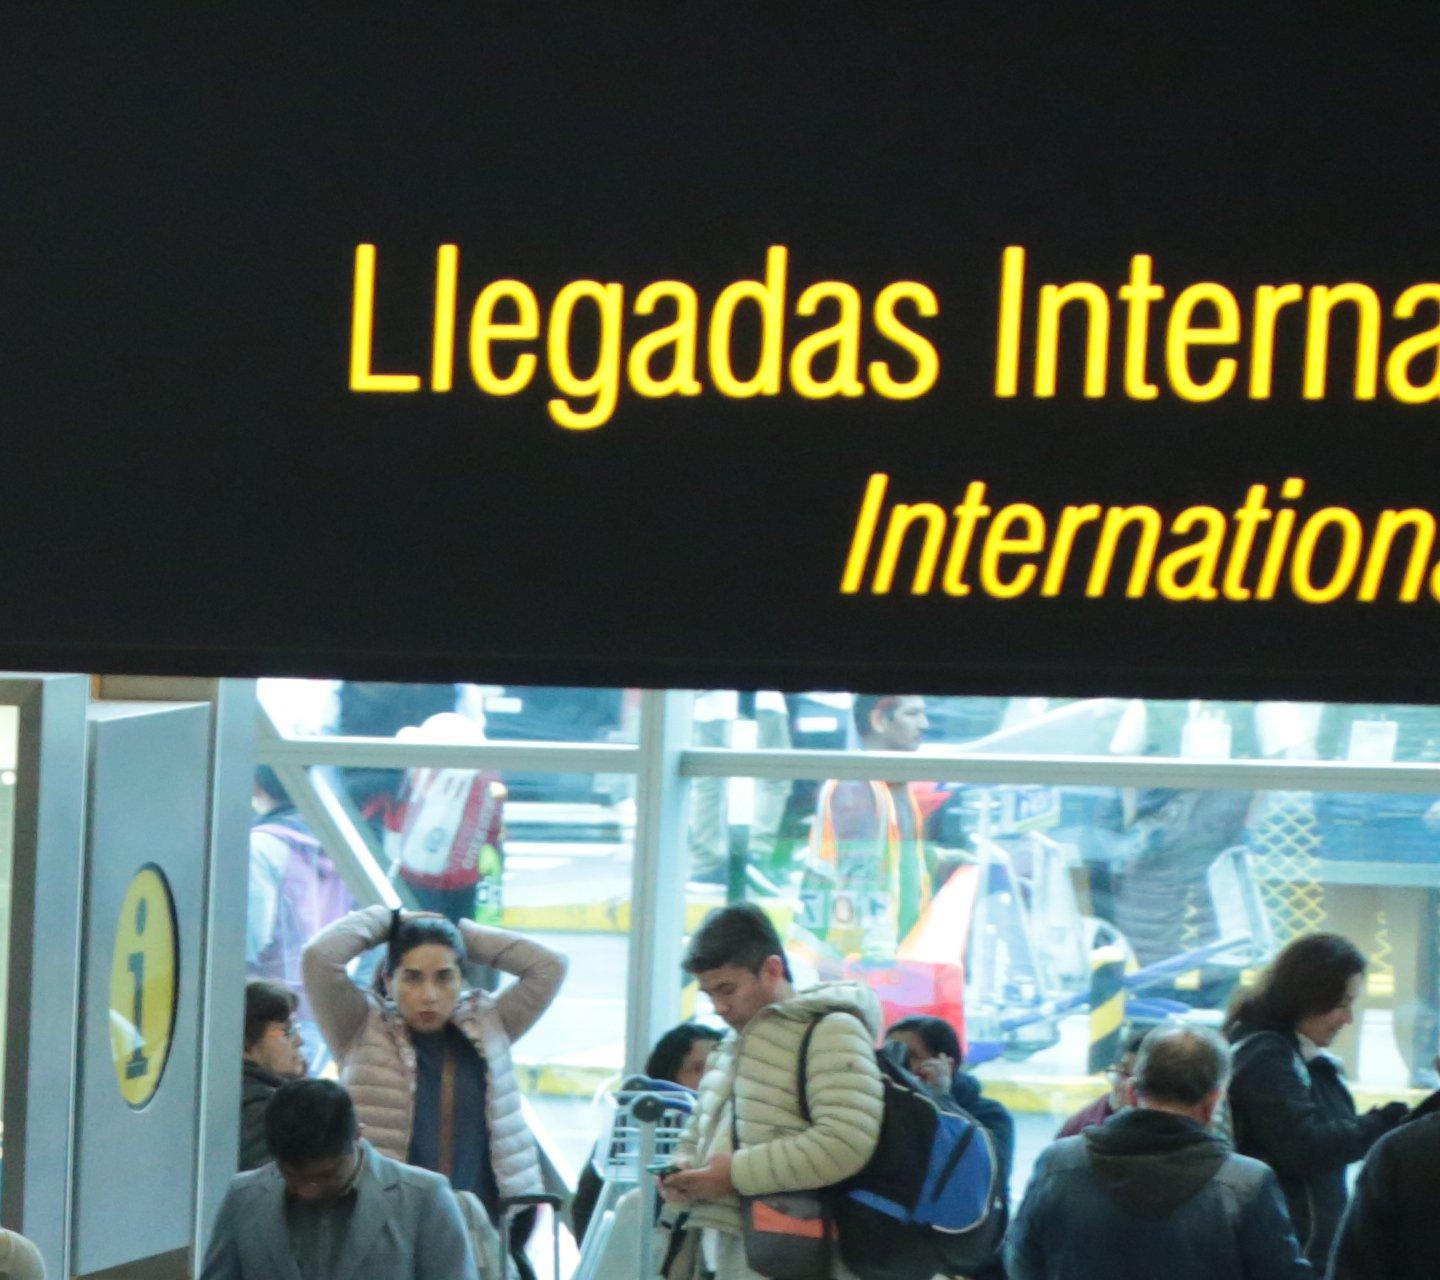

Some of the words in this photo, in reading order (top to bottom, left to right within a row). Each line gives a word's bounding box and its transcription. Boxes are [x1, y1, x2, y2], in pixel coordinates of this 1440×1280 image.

[349, 243, 939, 431] Llegadas
[994, 245, 1440, 404] Interna
[840, 473, 1440, 604] Internation
